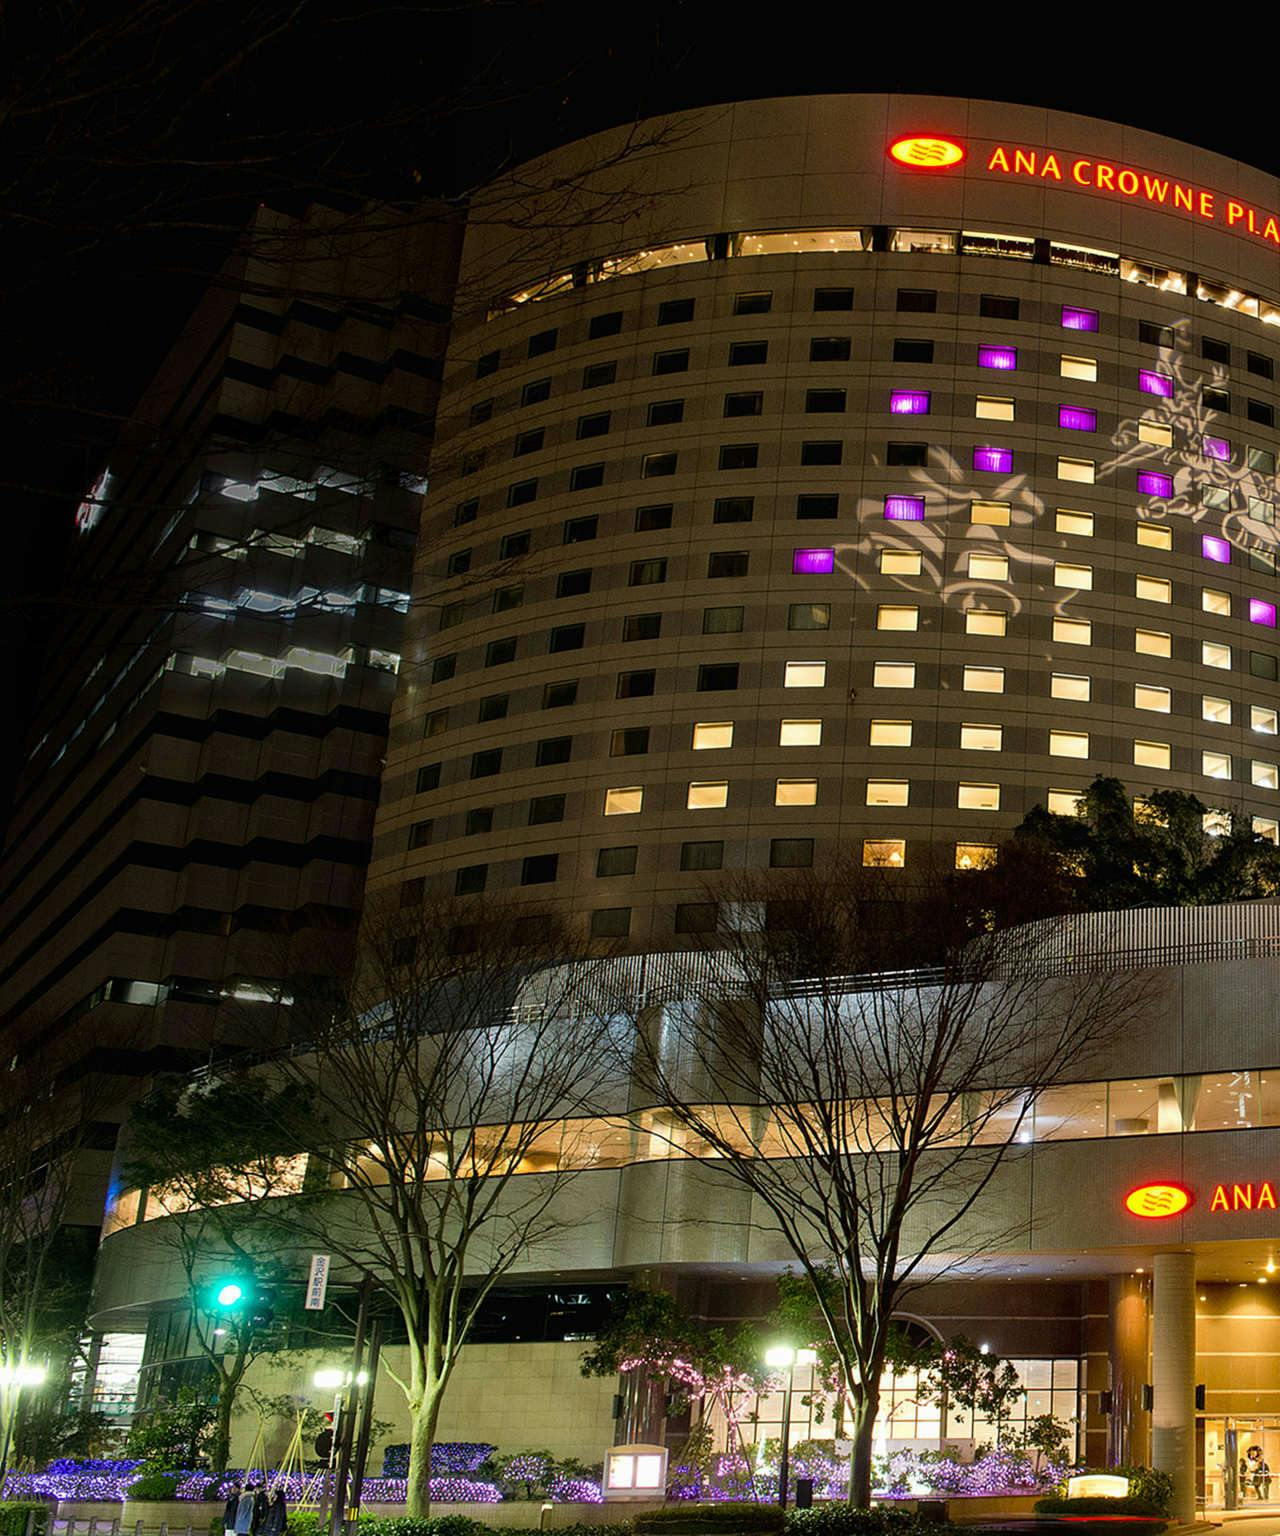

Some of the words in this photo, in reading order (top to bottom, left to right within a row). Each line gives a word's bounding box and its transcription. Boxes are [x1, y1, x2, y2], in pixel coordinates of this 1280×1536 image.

[987, 147, 1063, 181] ANA
[1070, 160, 1215, 219] CROWNE
[1208, 1180, 1278, 1213] ANA
